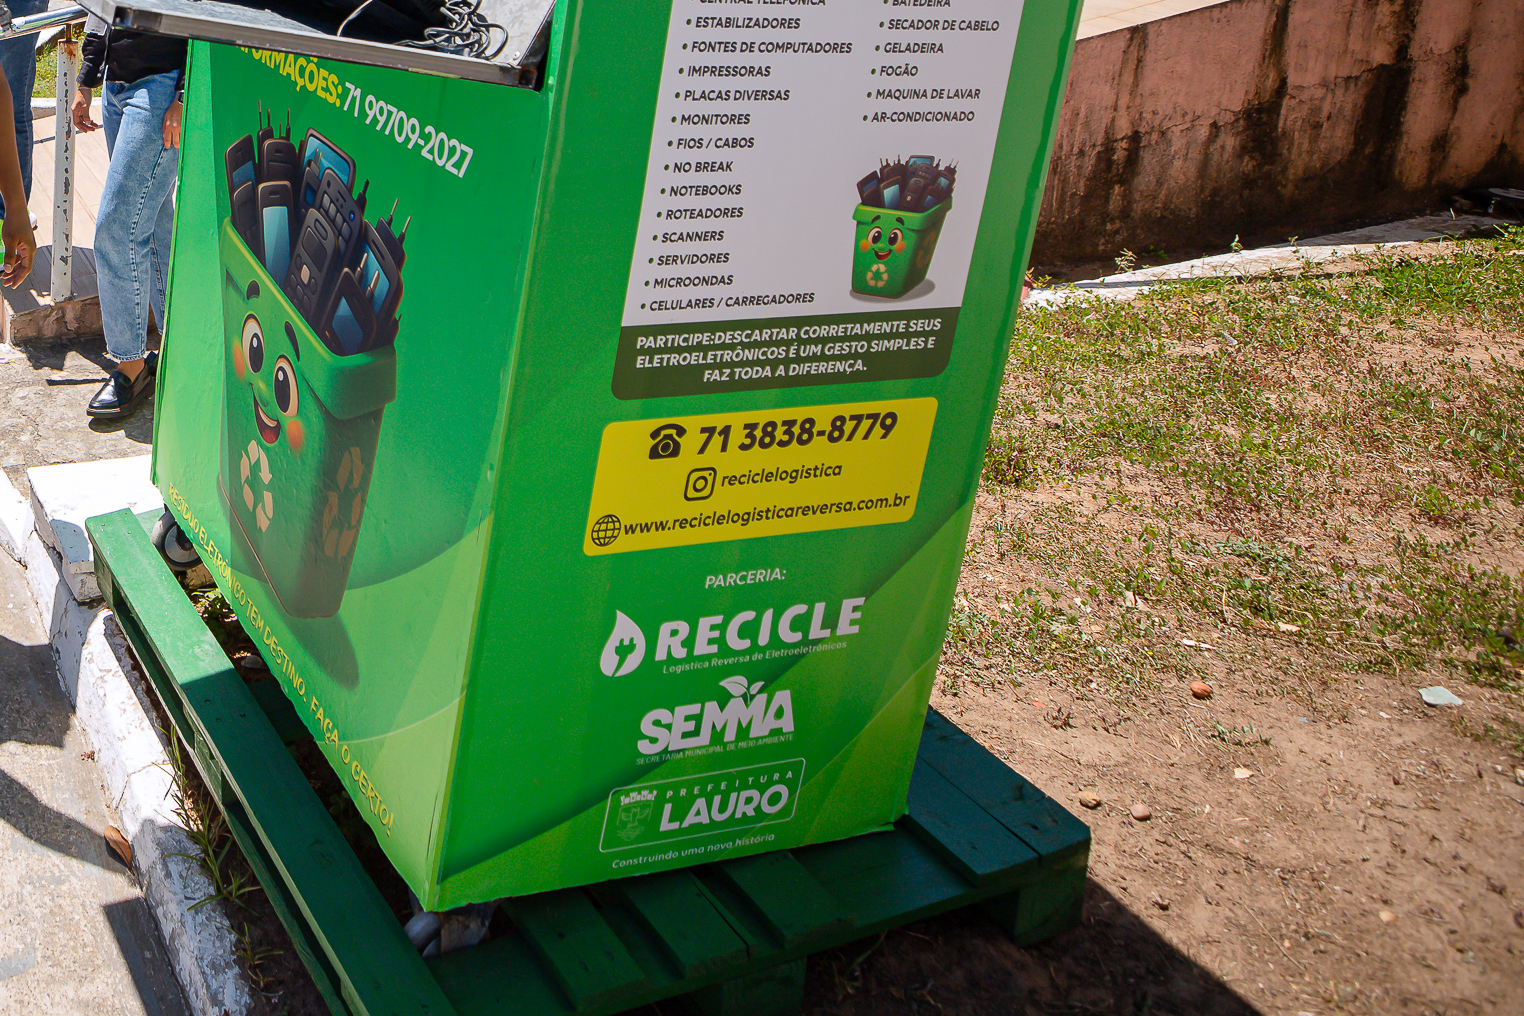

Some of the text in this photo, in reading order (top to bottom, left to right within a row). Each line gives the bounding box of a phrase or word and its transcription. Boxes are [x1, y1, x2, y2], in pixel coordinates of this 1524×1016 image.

[696, 17, 800, 29] ESTABILIZADORES
[888, 19, 999, 31] SECADOR DE CABELO
[692, 41, 852, 53] FONTES DE COMPUTADORES
[884, 42, 943, 53] GELADEIRA
[688, 66, 771, 77] IMPRESSORAS
[880, 63, 918, 76] FOGÃO
[684, 90, 790, 101] PLACAS DIVERSAS
[876, 89, 980, 101] MAQUINA DE LAVAR
[681, 114, 750, 125] MONITORES
[871, 111, 974, 122] AR-CONDICIONADO
[343, 82, 362, 117] 71
[365, 94, 474, 178] 99709-2027
[677, 138, 704, 149] FIOS
[715, 137, 754, 148] CABOS
[674, 161, 733, 173] NO BREAK
[670, 184, 742, 196] NOTEBOOKS
[666, 207, 743, 220] ROTEADORES
[662, 231, 724, 243] SCANNERS
[658, 253, 730, 266] SERVIDORES
[654, 275, 733, 288] MICROONDAS
[650, 298, 715, 311] CELULARES
[726, 293, 815, 307] CARREGADORES
[801, 321, 907, 338] CORRETAMENTE
[909, 319, 942, 331] SEUS
[636, 337, 936, 368] ELETROELETRÔNICOS É UM GESTO SIMPLES E
[704, 360, 867, 382] FAZ TODA A DIFERENÇA.
[697, 412, 898, 455] 71 3838-8779
[722, 463, 842, 487] reciclelogistica
[624, 493, 910, 535] www.reciclelogisticareversa.com.br
[705, 568, 786, 589] PARCERIA:
[655, 597, 866, 661] RECICLE
[168, 482, 199, 535] RESÍDUO
[246, 595, 264, 630] TEM
[263, 626, 307, 703] DESTINO.
[309, 696, 339, 753] FAÇA
[341, 744, 351, 764] O
[351, 761, 394, 837] CERTO!
[711, 654, 750, 668] Reversa
[752, 652, 763, 661] de
[637, 689, 795, 755] SEMMA
[636, 734, 794, 765] SECRETARIA MUNICIPAL DE MEIO AMBIENTE
[666, 771, 793, 799] PREFEITURA
[660, 784, 789, 832] LAURO
[612, 833, 775, 869] Construindo uma nova história
